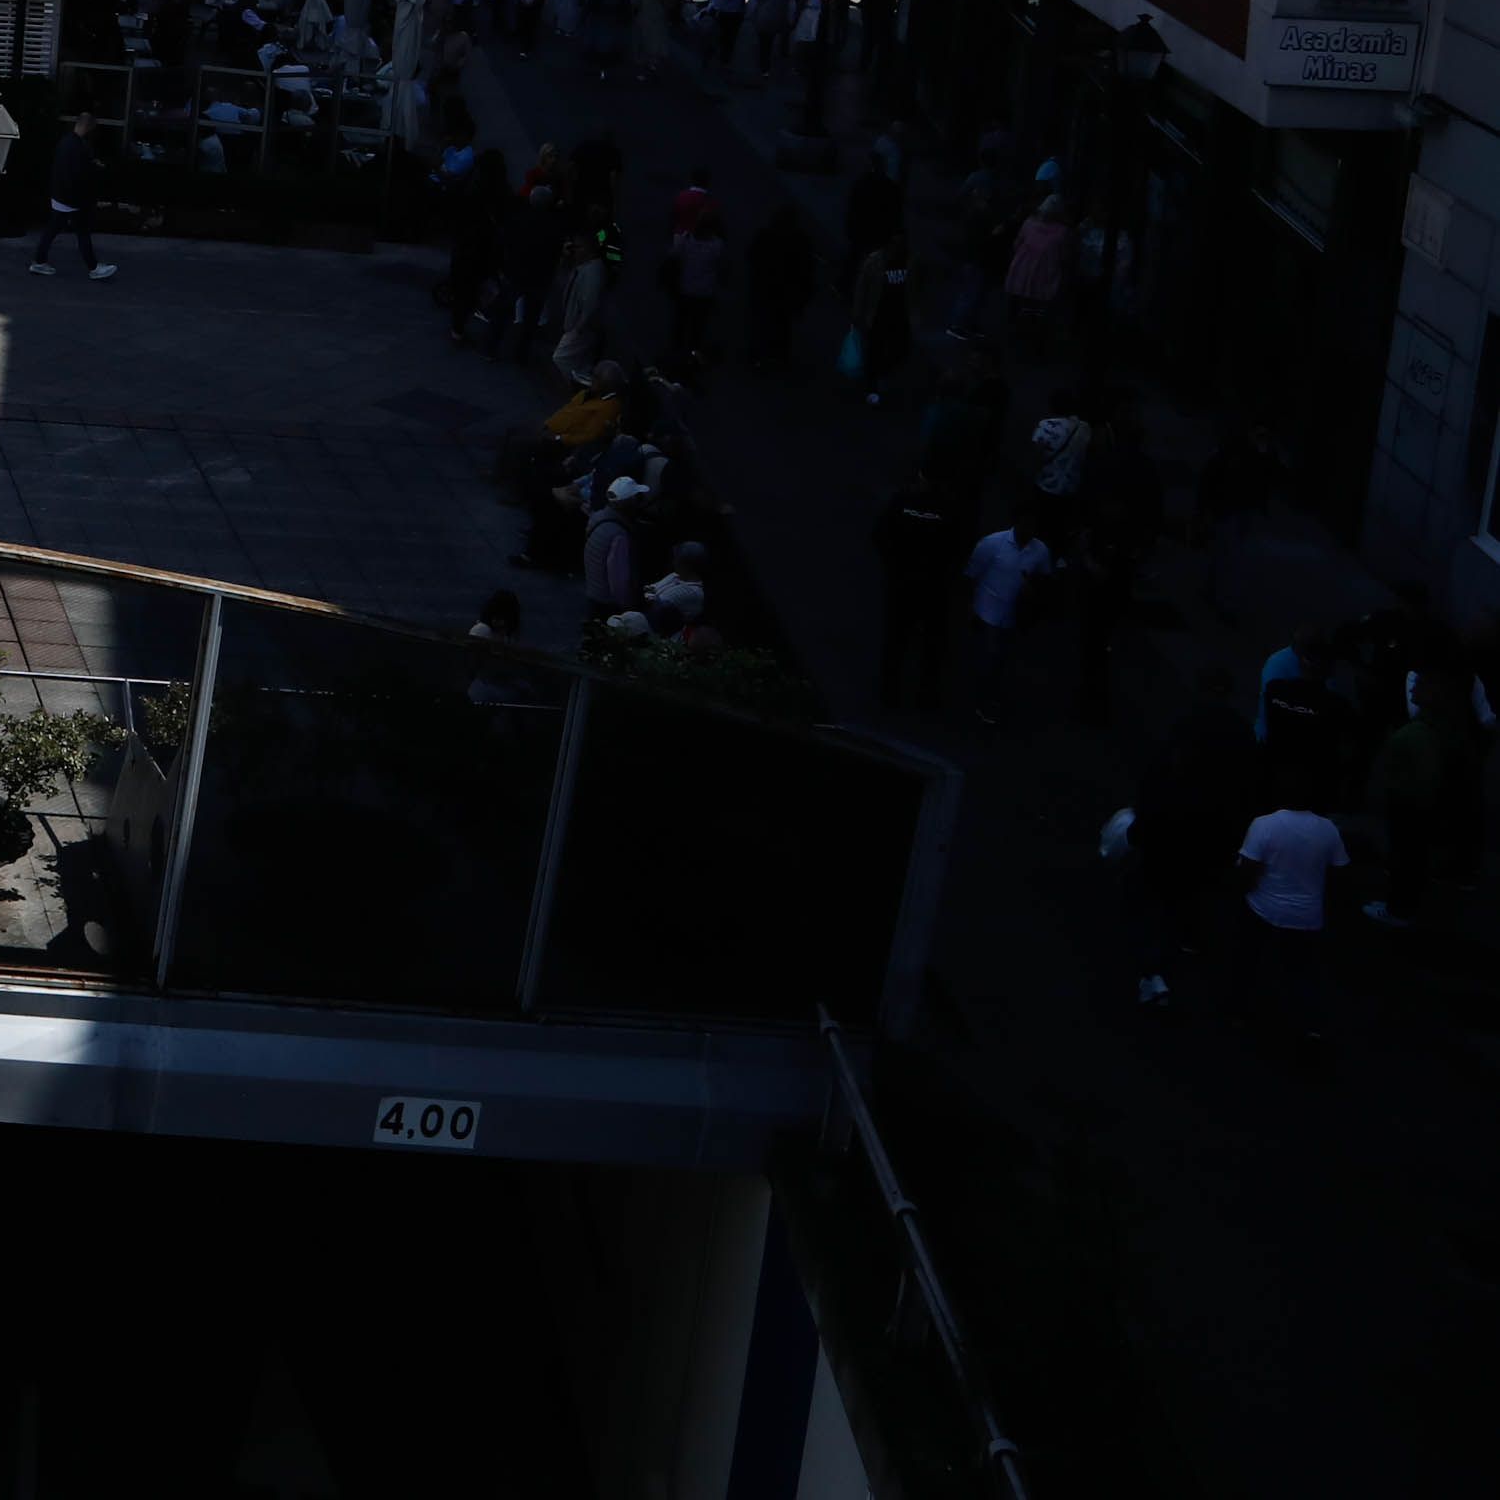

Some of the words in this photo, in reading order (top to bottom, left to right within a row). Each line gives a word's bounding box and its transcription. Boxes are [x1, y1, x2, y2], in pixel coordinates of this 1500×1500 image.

[1280, 26, 1408, 56] Academia
[1302, 55, 1377, 82] Minas
[380, 1102, 474, 1140] 4,00
